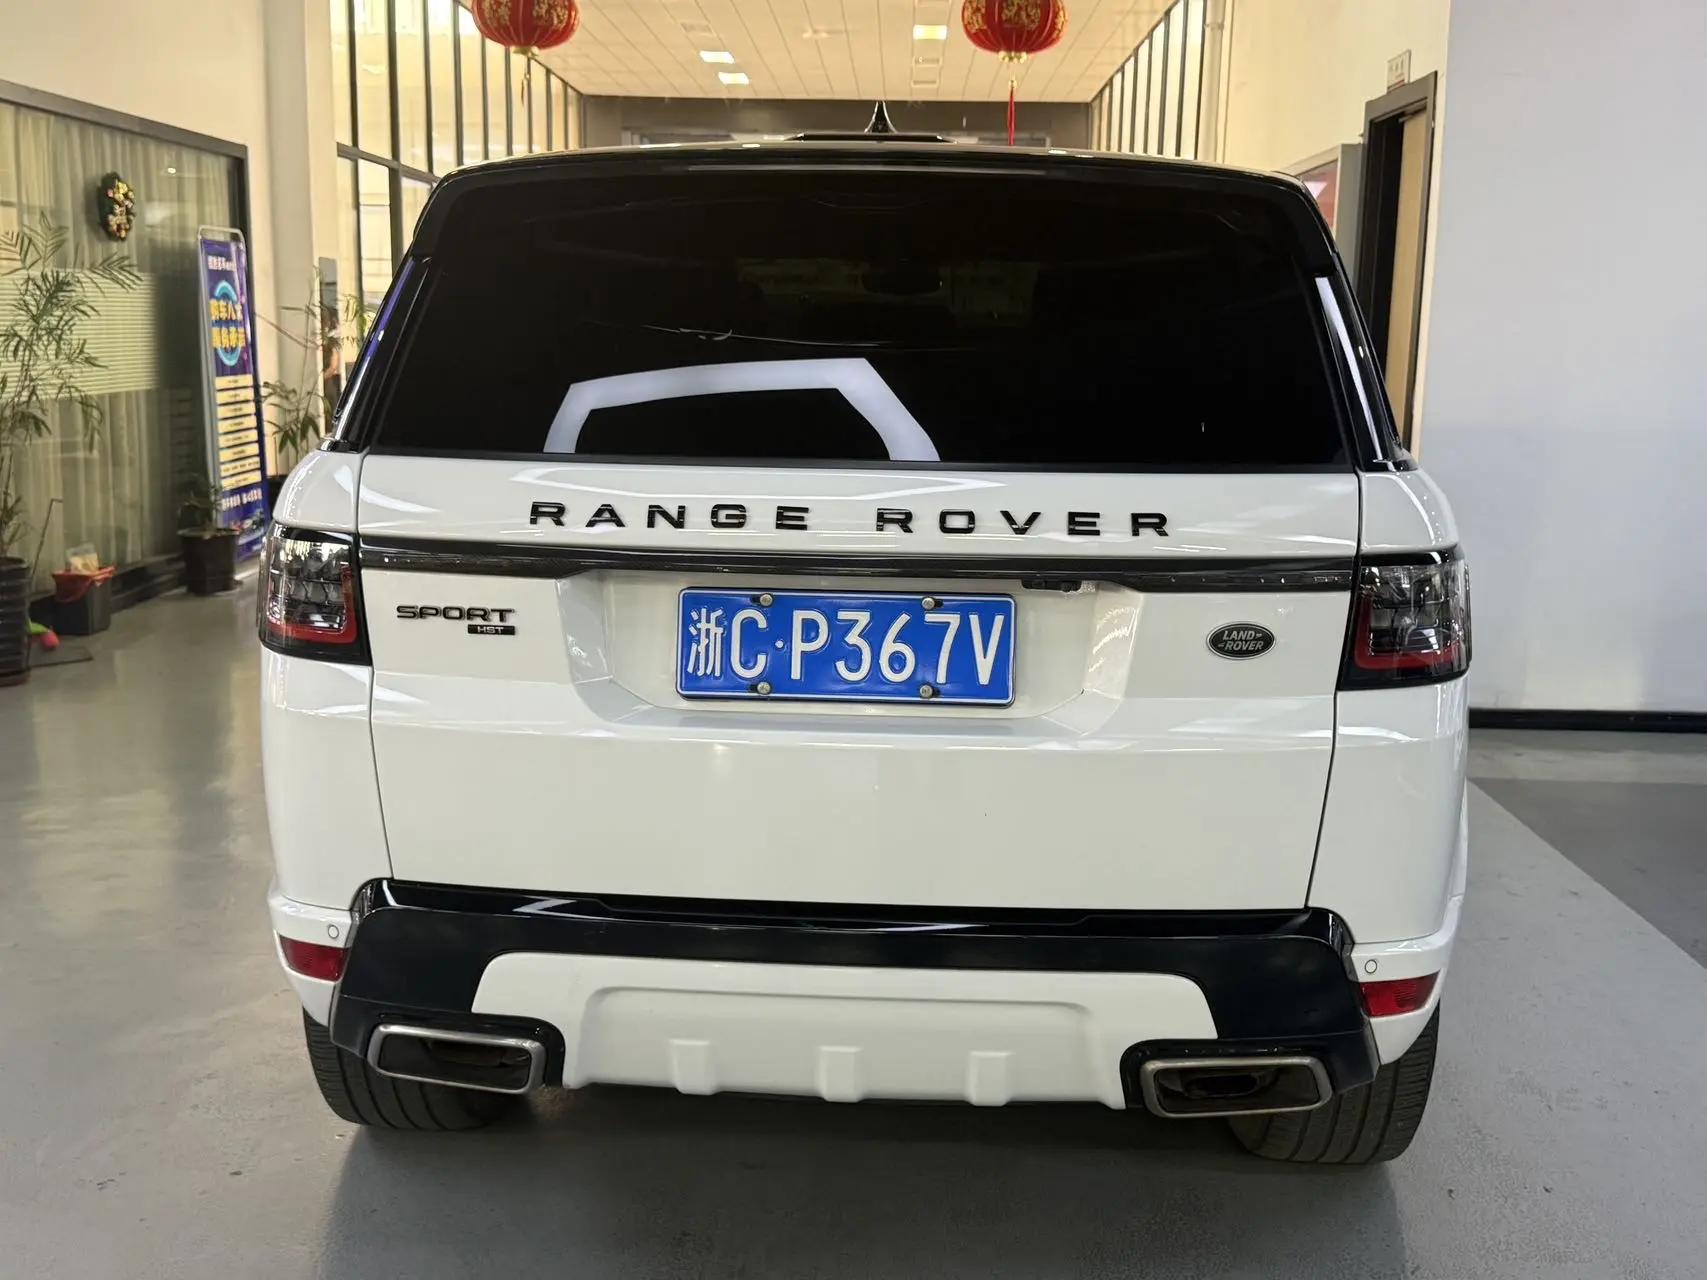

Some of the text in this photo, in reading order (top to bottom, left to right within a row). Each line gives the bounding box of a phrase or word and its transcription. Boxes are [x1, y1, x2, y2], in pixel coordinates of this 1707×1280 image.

[529, 502, 1169, 537] RANGE ROVER
[396, 605, 515, 622] SPORT
[477, 626, 504, 634] HST
[1224, 641, 1264, 651] ROVER
